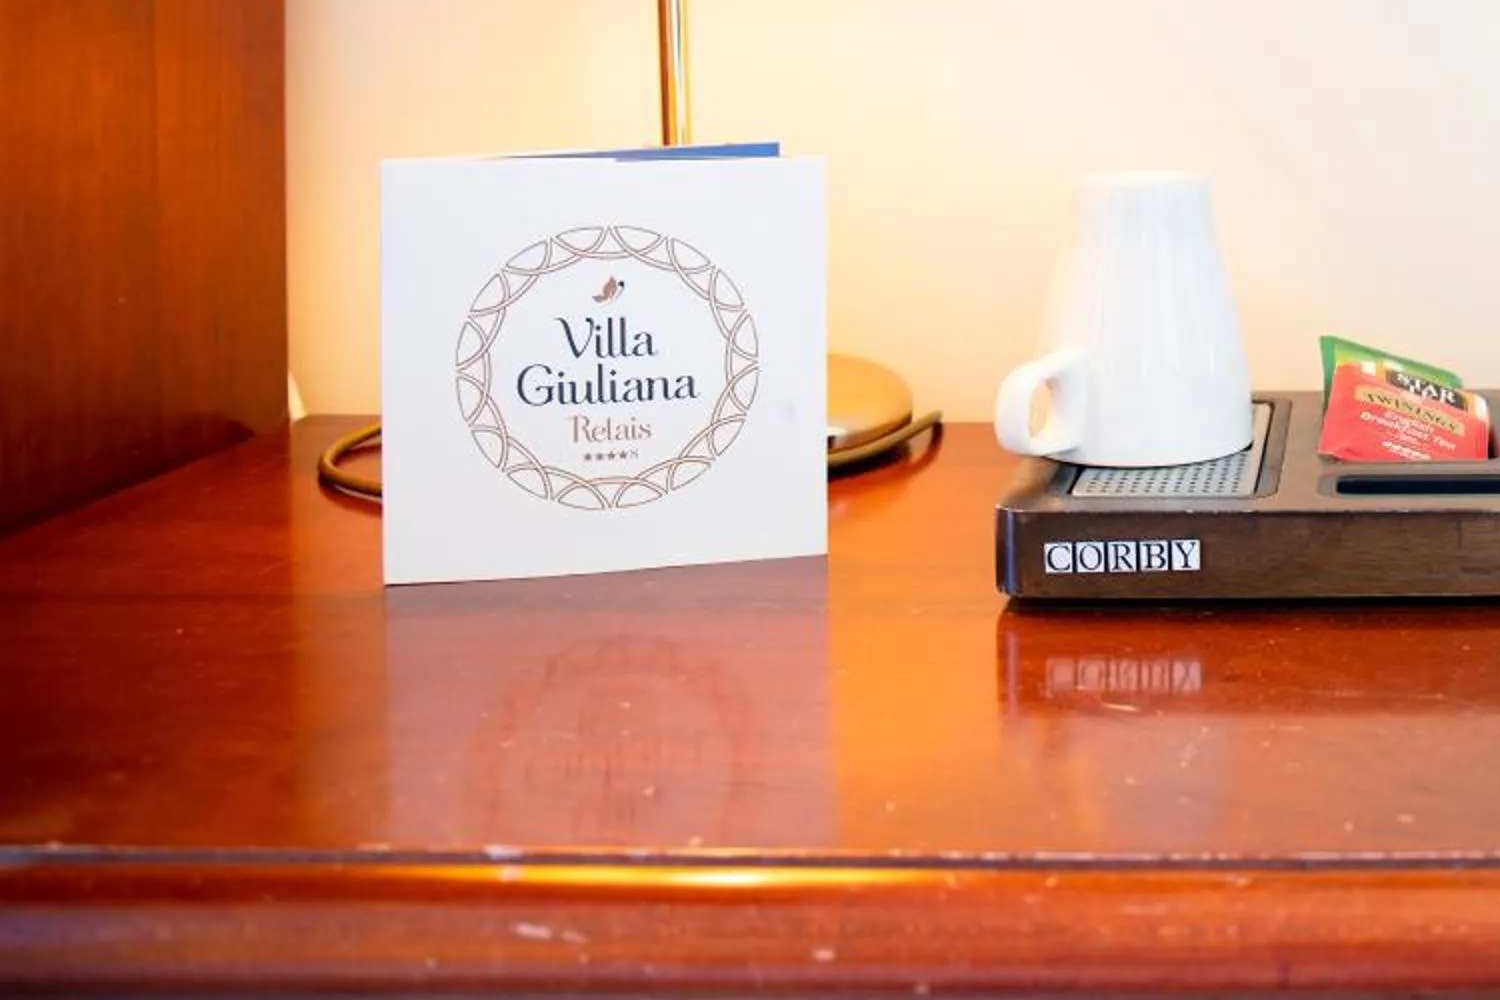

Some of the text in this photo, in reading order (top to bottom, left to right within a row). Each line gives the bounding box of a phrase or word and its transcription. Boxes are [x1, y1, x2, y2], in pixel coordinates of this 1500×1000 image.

[554, 316, 658, 359] Villa
[516, 363, 700, 407] Giuliana
[568, 415, 653, 443] Relais
[1046, 542, 1197, 572] CORBY
